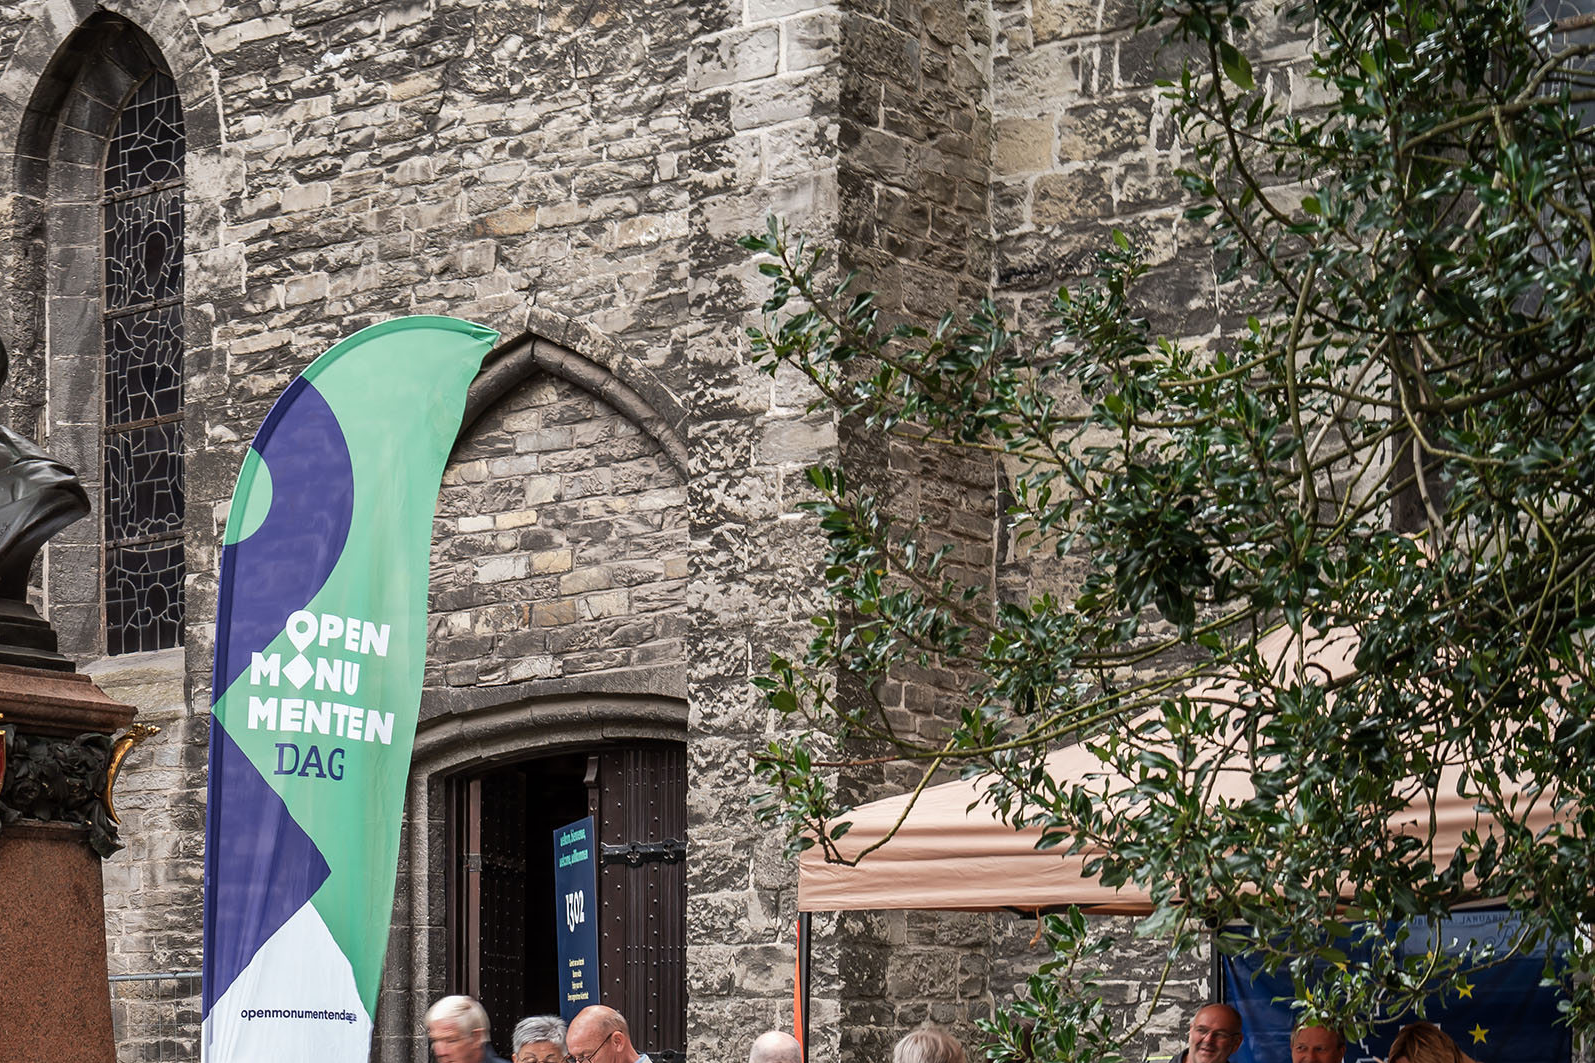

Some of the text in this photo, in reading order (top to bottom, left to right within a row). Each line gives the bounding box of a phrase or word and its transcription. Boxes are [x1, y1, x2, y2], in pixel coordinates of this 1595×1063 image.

[285, 609, 391, 657] OPEN
[247, 696, 395, 745] MENTEN
[273, 742, 345, 781] DAG
